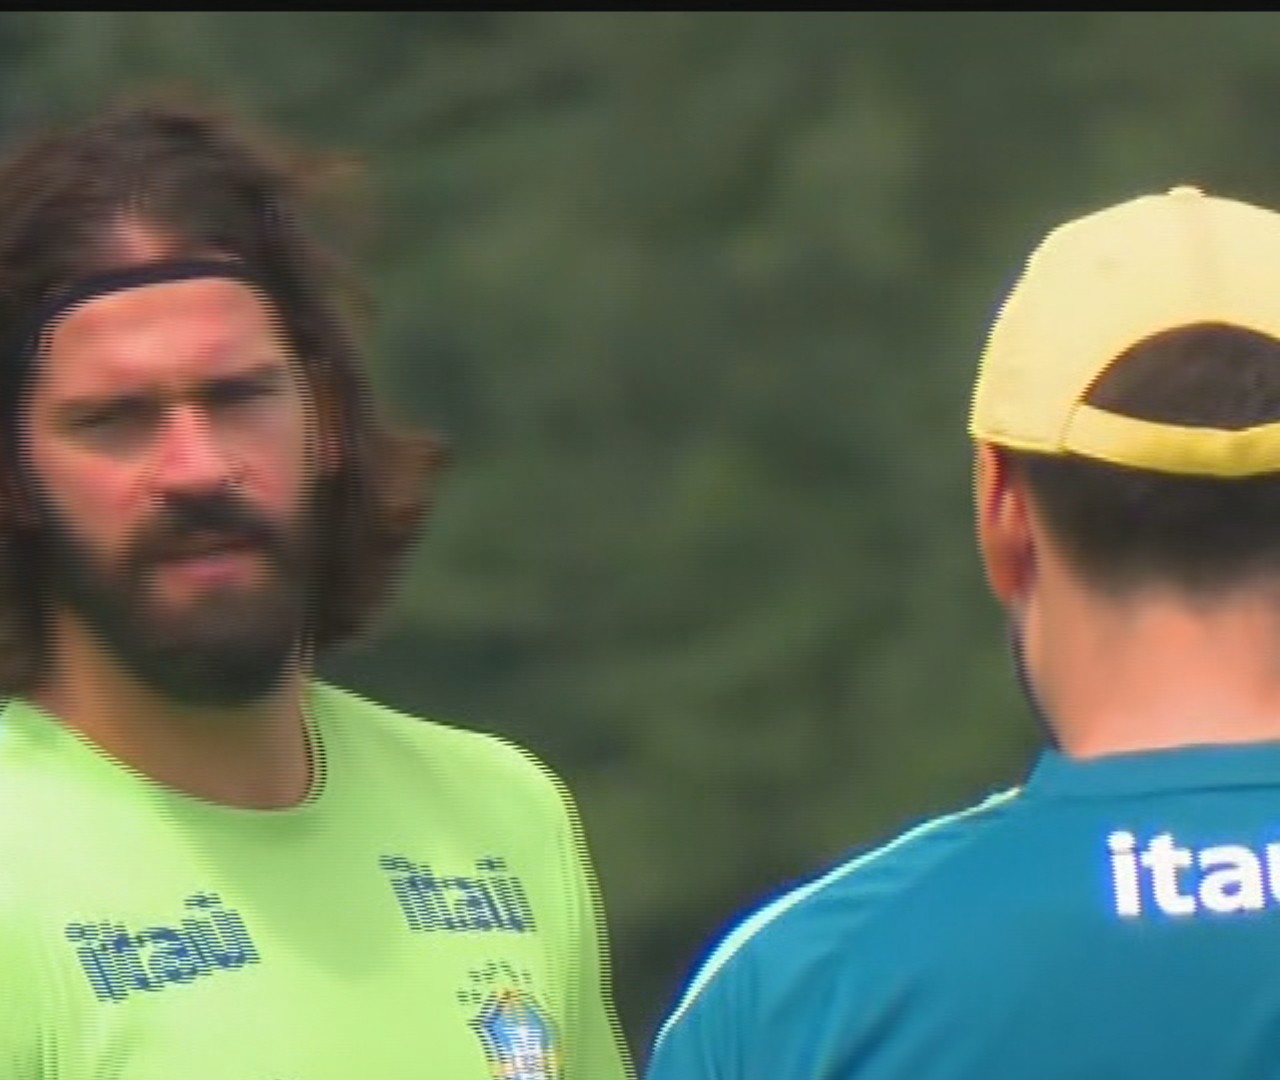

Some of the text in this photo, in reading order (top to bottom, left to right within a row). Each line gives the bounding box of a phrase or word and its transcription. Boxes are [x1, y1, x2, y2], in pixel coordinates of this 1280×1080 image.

[378, 855, 536, 933] itaú
[1107, 831, 1280, 916] ita
[65, 891, 261, 1003] itaú
